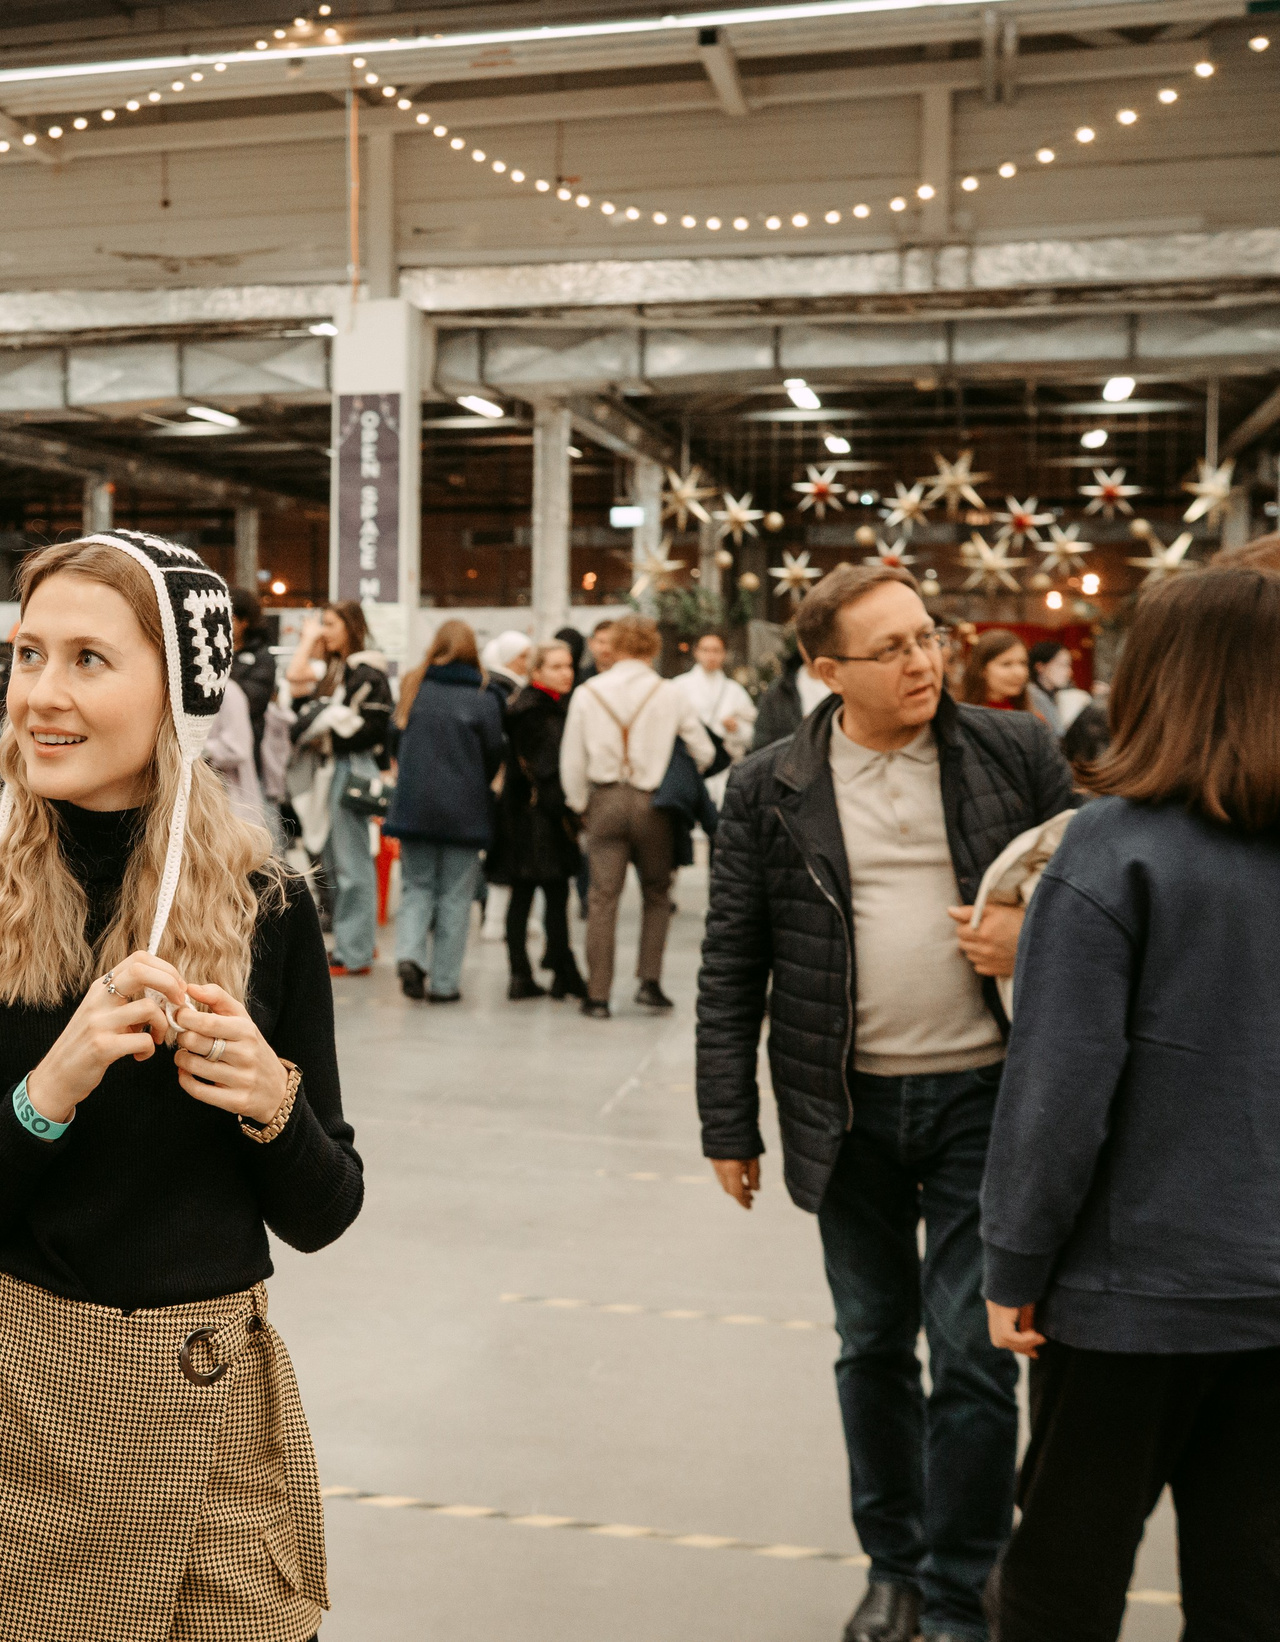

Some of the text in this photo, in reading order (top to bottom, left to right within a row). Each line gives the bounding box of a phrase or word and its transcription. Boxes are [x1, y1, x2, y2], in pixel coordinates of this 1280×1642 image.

[360, 410, 380, 478] OPEN
[359, 486, 380, 570] SPACE
[15, 1086, 50, 1133] OSM
